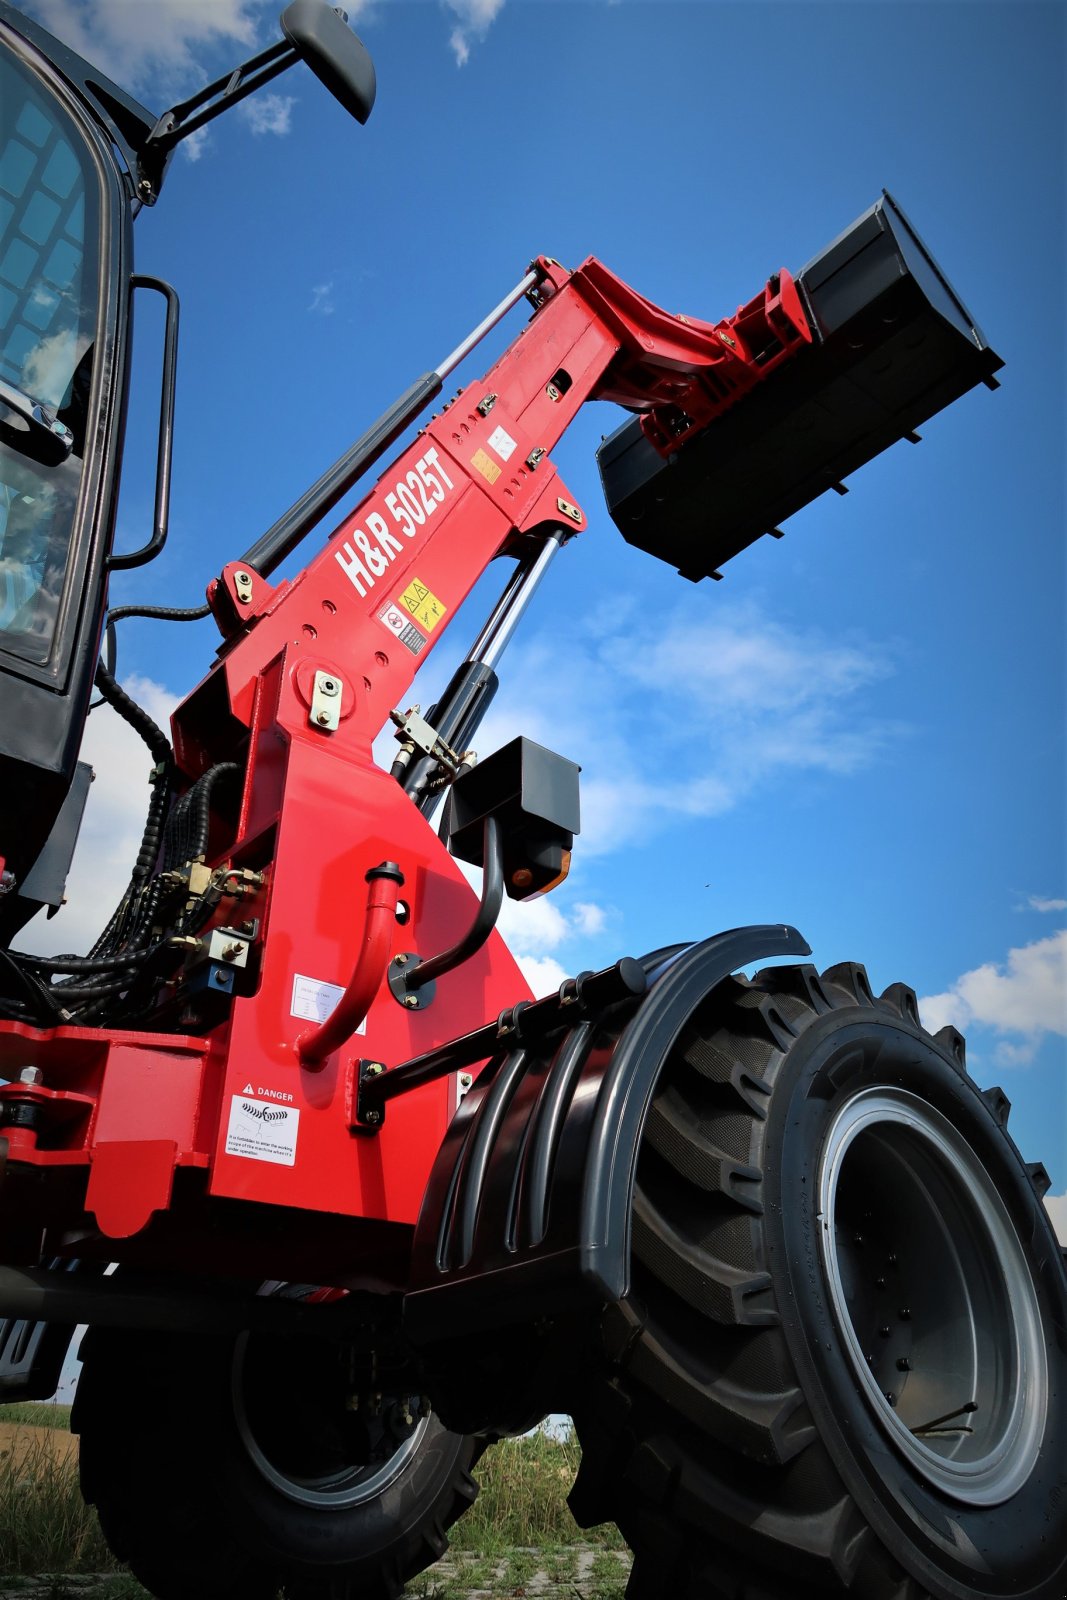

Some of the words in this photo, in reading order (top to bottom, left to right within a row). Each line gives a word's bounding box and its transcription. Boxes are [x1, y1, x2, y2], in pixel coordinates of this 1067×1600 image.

[334, 511, 404, 598] H&R
[384, 446, 454, 538] 5025T
[257, 1087, 293, 1102] DANGER
[237, 1135, 255, 1144] forbidden
